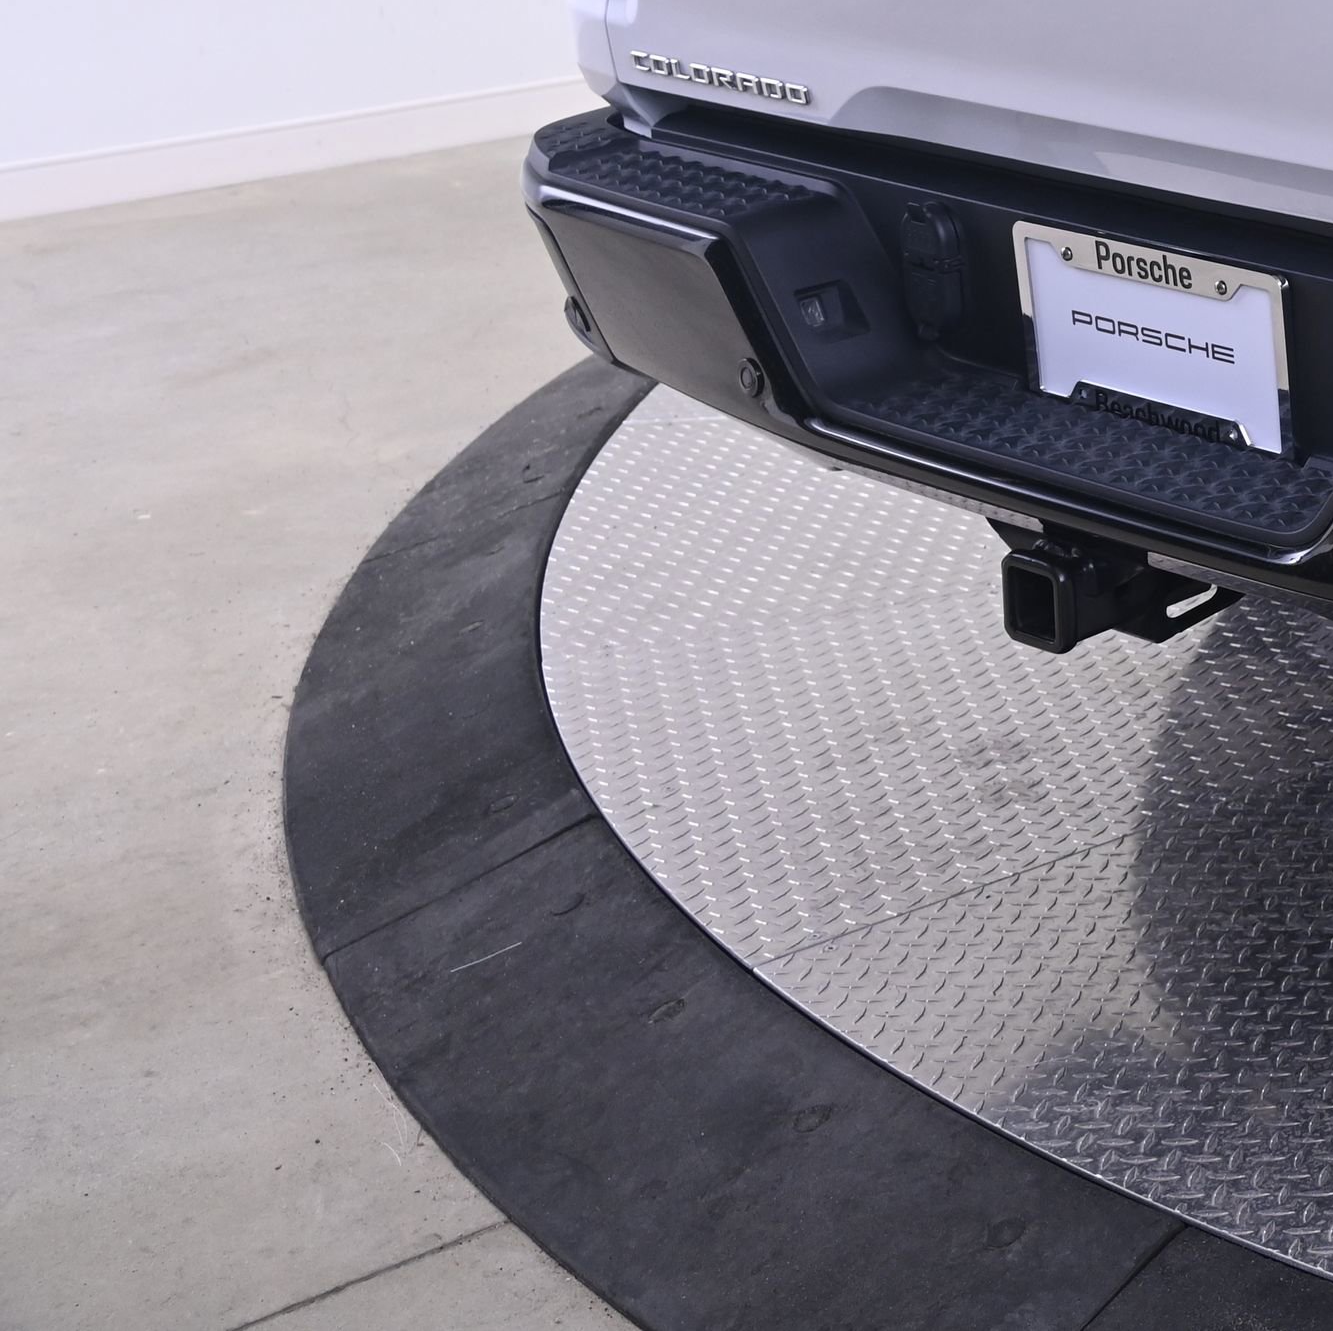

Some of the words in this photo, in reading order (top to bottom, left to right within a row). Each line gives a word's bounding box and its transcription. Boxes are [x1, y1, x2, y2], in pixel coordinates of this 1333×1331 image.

[630, 50, 810, 105] COLORADO
[1095, 240, 1193, 289] Porsche
[1071, 310, 1236, 364] PORSCHE
